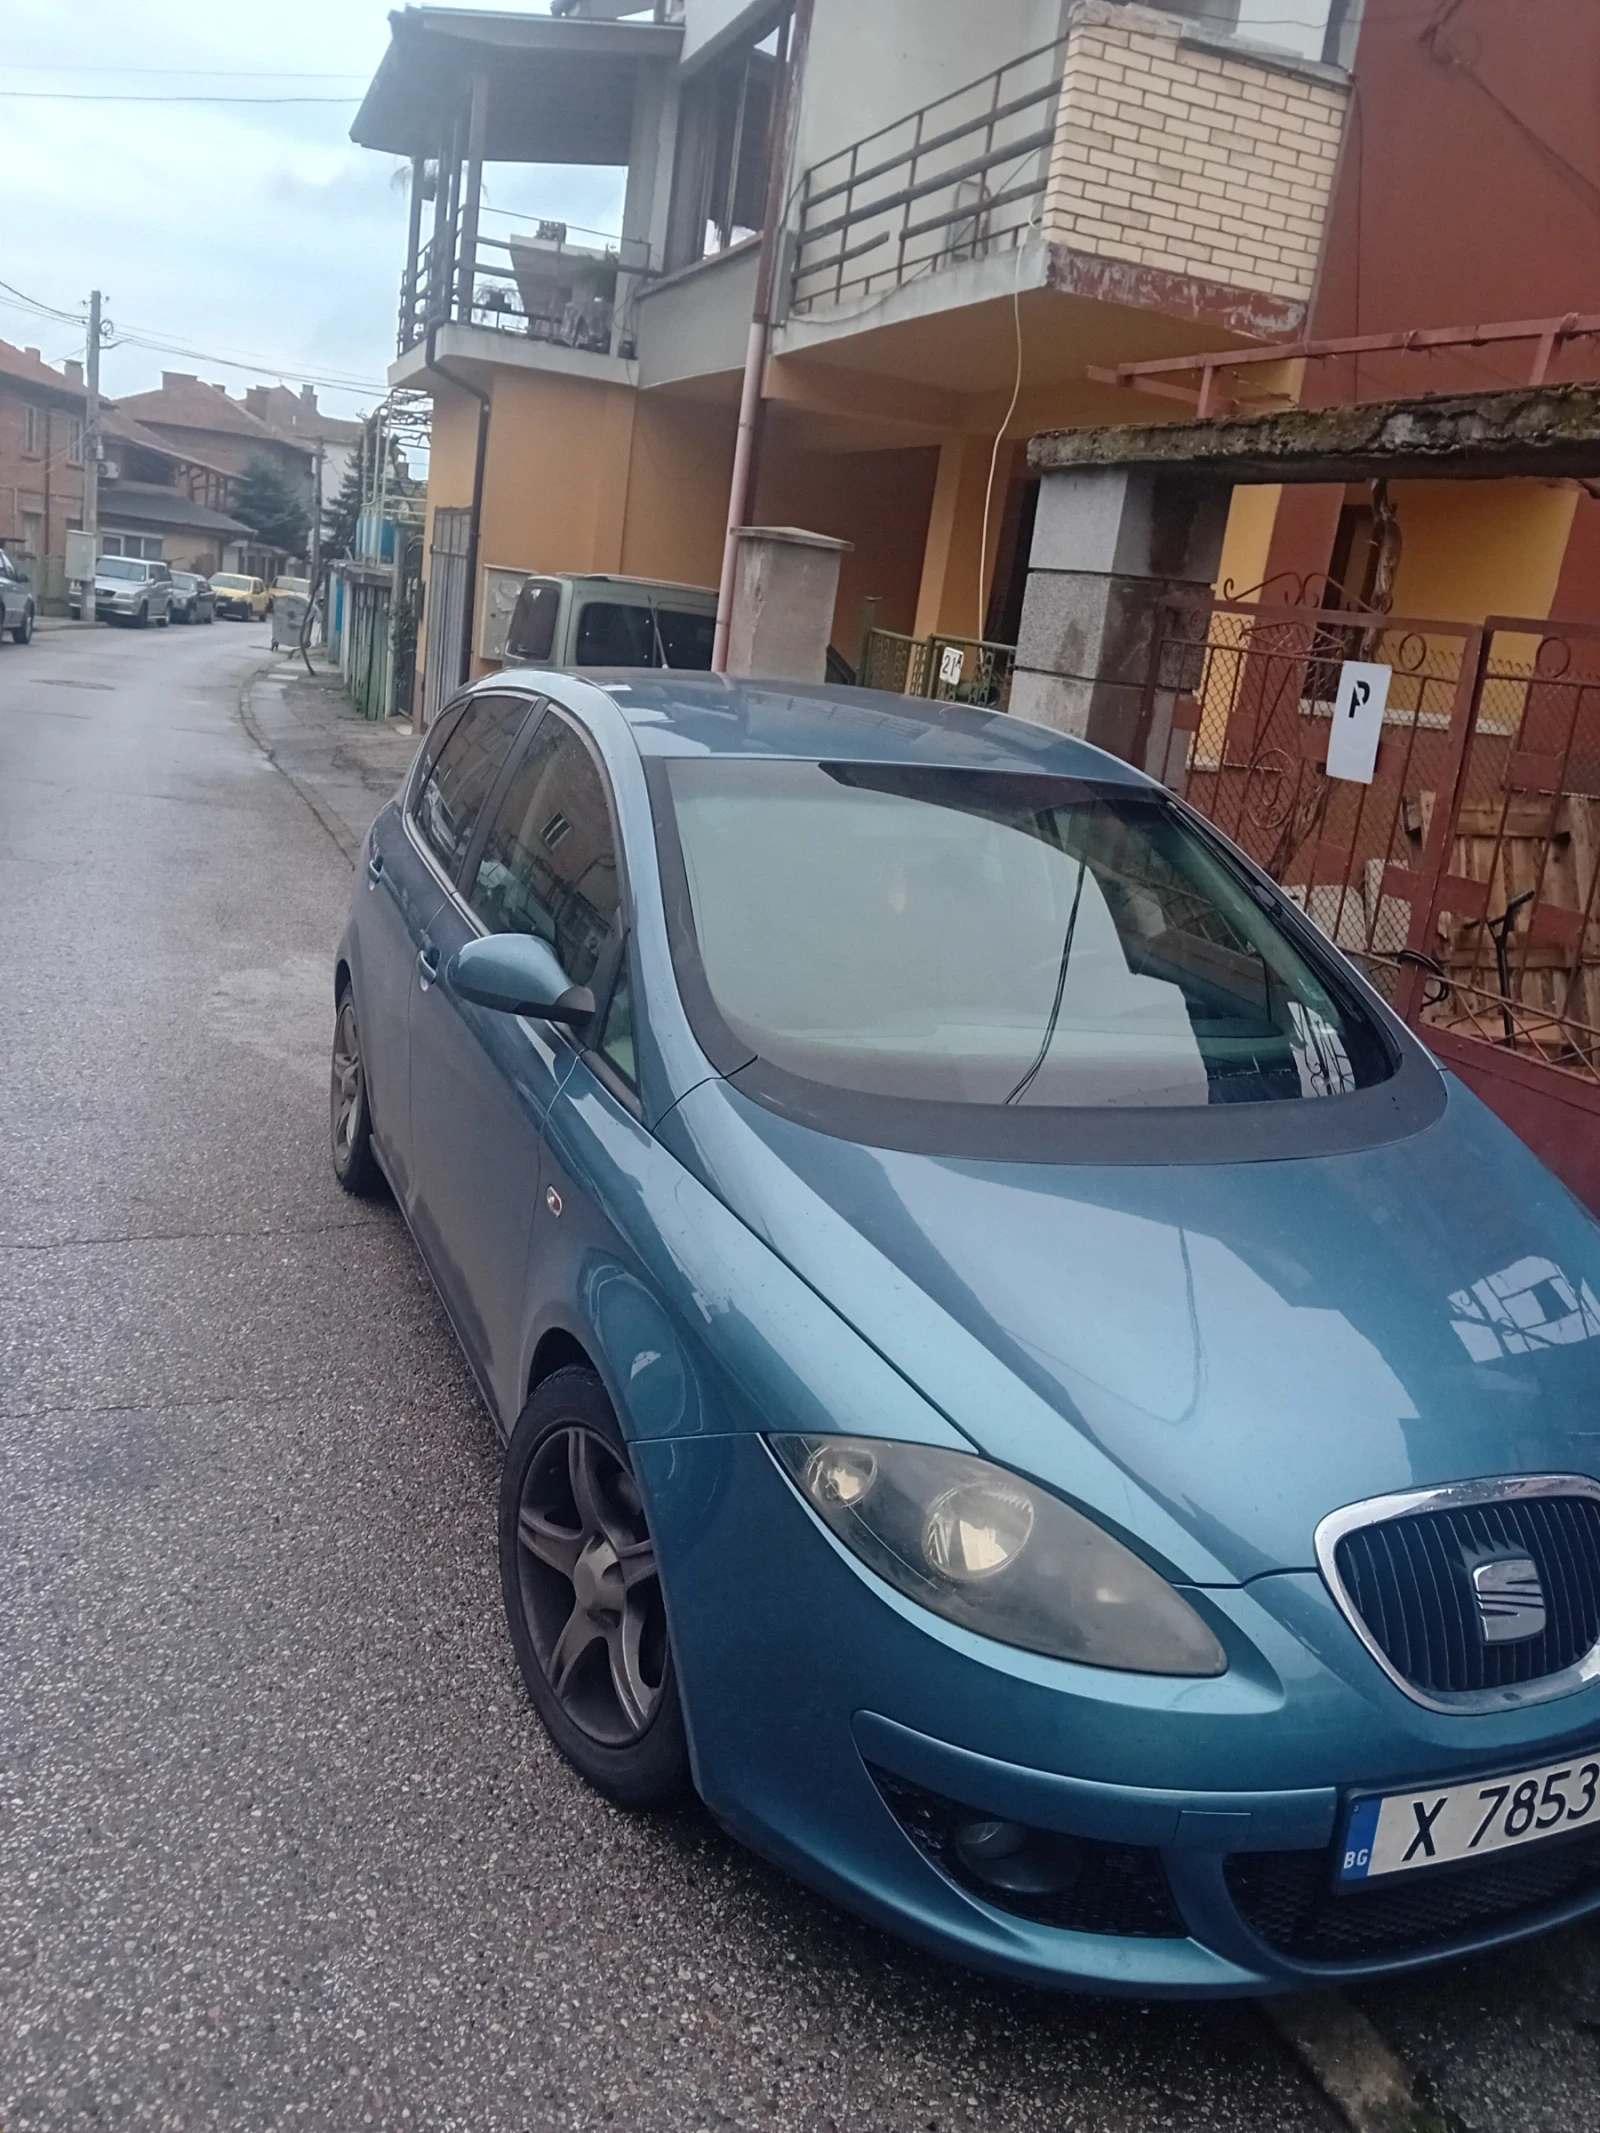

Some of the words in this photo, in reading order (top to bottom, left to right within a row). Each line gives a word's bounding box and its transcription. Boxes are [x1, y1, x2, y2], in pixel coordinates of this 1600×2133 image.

[1348, 680, 1370, 719] P
[1401, 1797, 1449, 1862] X
[1468, 1762, 1600, 1848] 7853
[1343, 1848, 1369, 1869] BG
